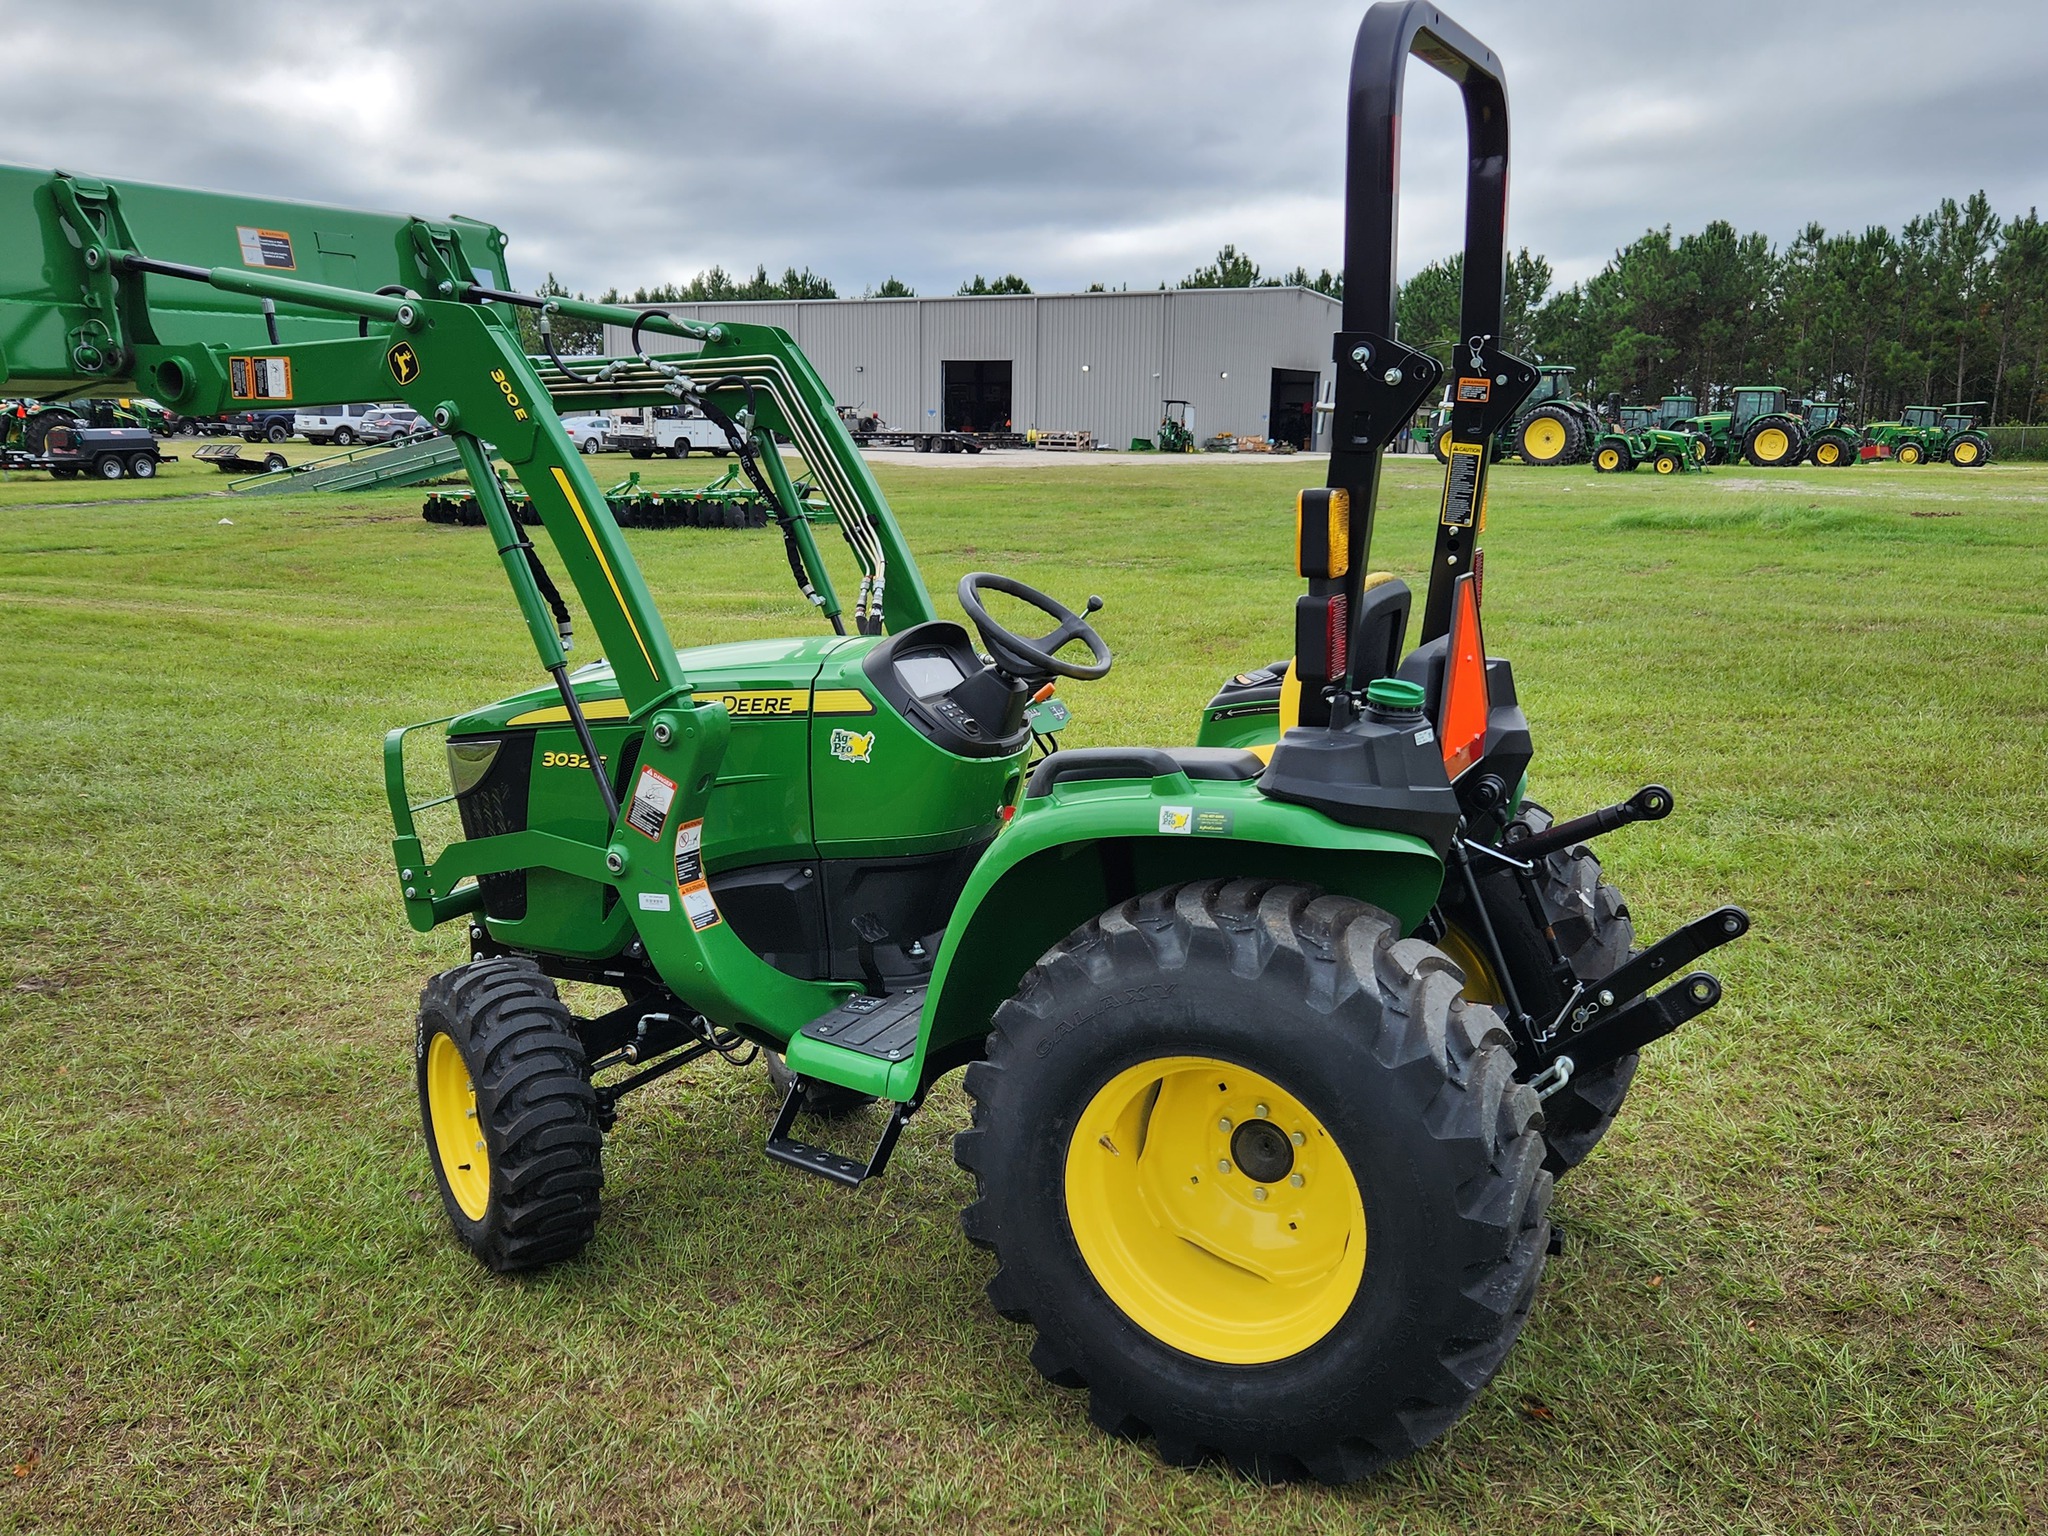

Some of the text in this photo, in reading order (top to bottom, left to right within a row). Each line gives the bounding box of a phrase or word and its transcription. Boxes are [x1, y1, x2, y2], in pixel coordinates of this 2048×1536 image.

[1459, 446, 1481, 454] CAUTION
[722, 695, 793, 713] DEERE
[833, 743, 853, 753] Pro
[653, 772, 674, 788] DANGER
[1035, 983, 1179, 1058] GALAXY
